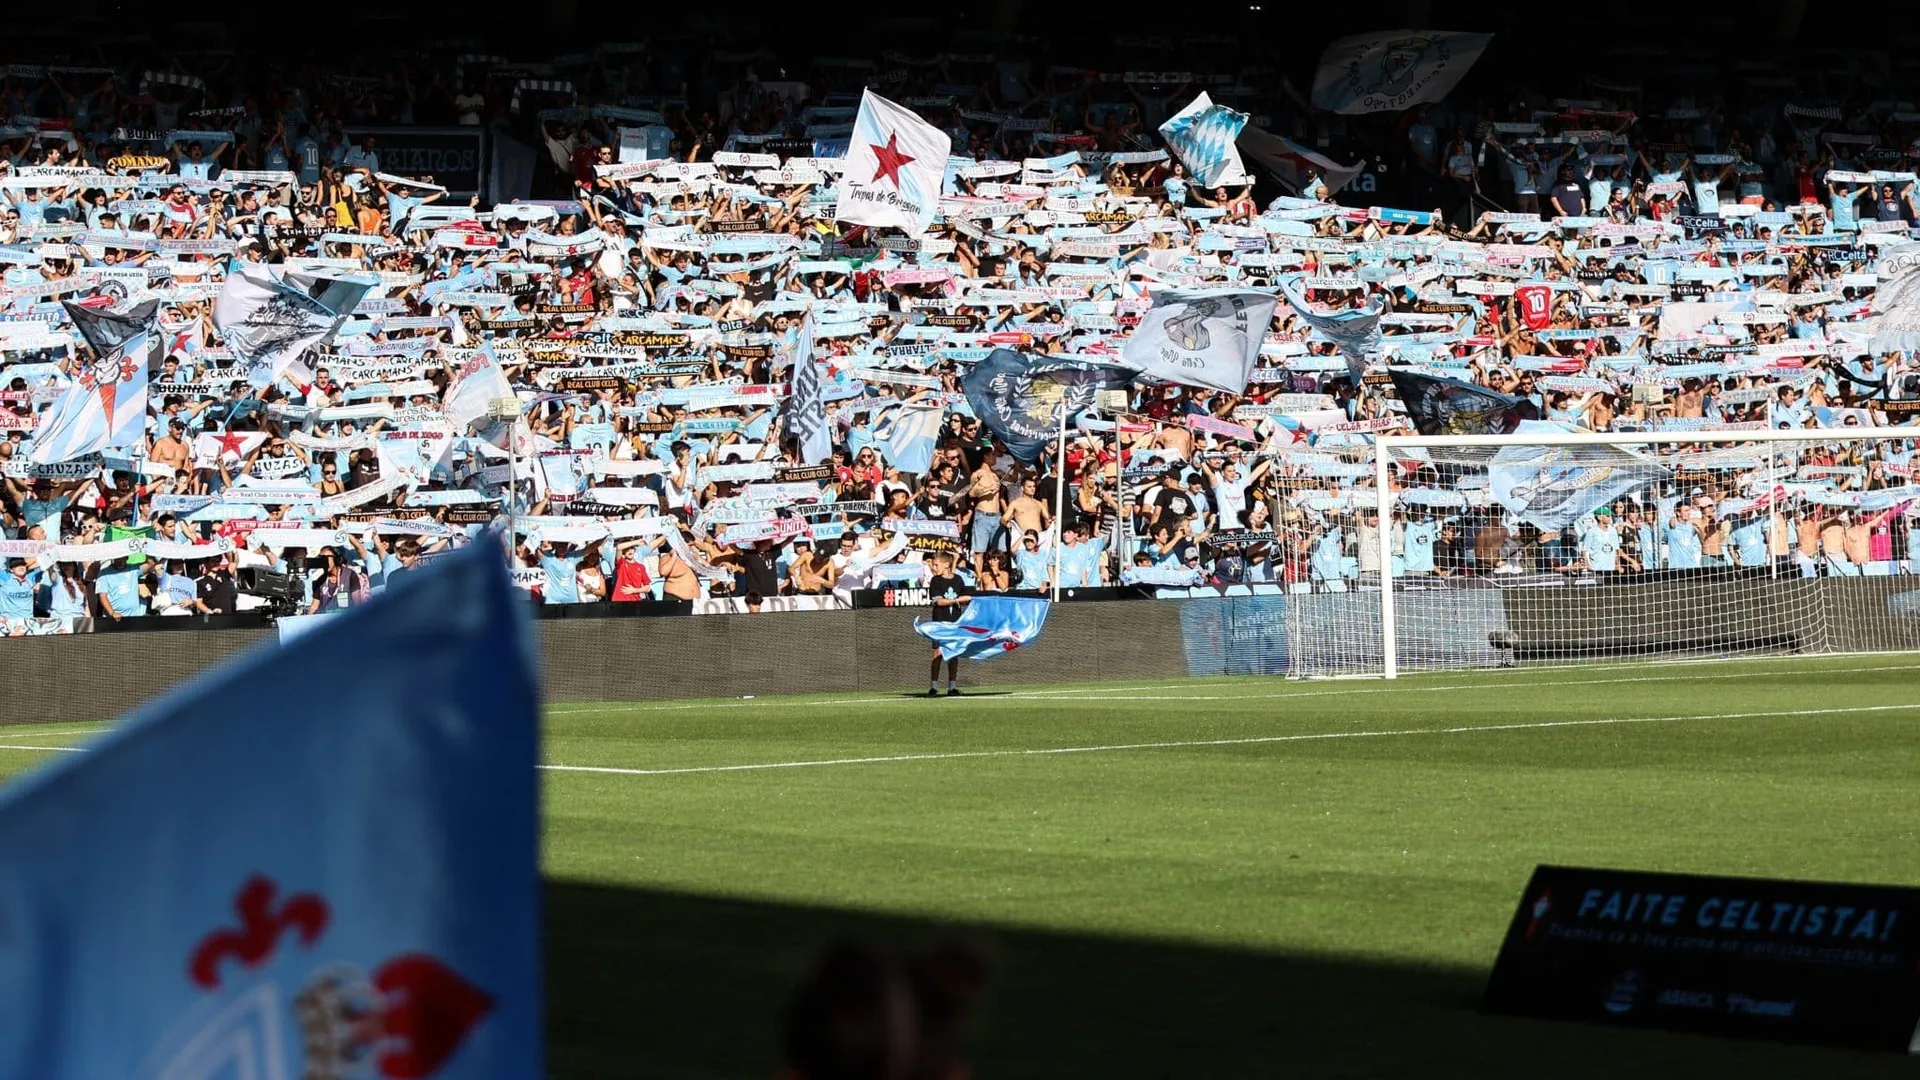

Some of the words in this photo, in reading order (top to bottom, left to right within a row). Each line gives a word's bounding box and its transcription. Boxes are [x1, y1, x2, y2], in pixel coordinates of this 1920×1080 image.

[306, 148, 319, 165] 10
[877, 190, 887, 202] de
[1695, 216, 1720, 228] Celta
[1841, 250, 1867, 261] Celta
[1653, 266, 1666, 283] 10
[560, 304, 577, 313] CLUB
[576, 304, 595, 312] CELTA
[1530, 294, 1545, 313] 10
[503, 320, 518, 329] CLUB
[619, 334, 685, 346] CARCAMANS
[566, 381, 583, 389] REAL
[583, 380, 600, 389] CLUB
[600, 380, 619, 388] CELTA
[408, 432, 420, 440] DE
[785, 472, 800, 481] REAL
[799, 471, 812, 480] CLUB
[254, 491, 268, 499] Club
[292, 491, 306, 501] Vigo
[204, 507, 242, 519] Celta
[447, 512, 461, 521] REAL
[460, 512, 475, 522] CLUB
[475, 512, 492, 522] CELTA
[1576, 887, 1689, 928] FAITE
[1696, 897, 1901, 943] CELTISTA!
